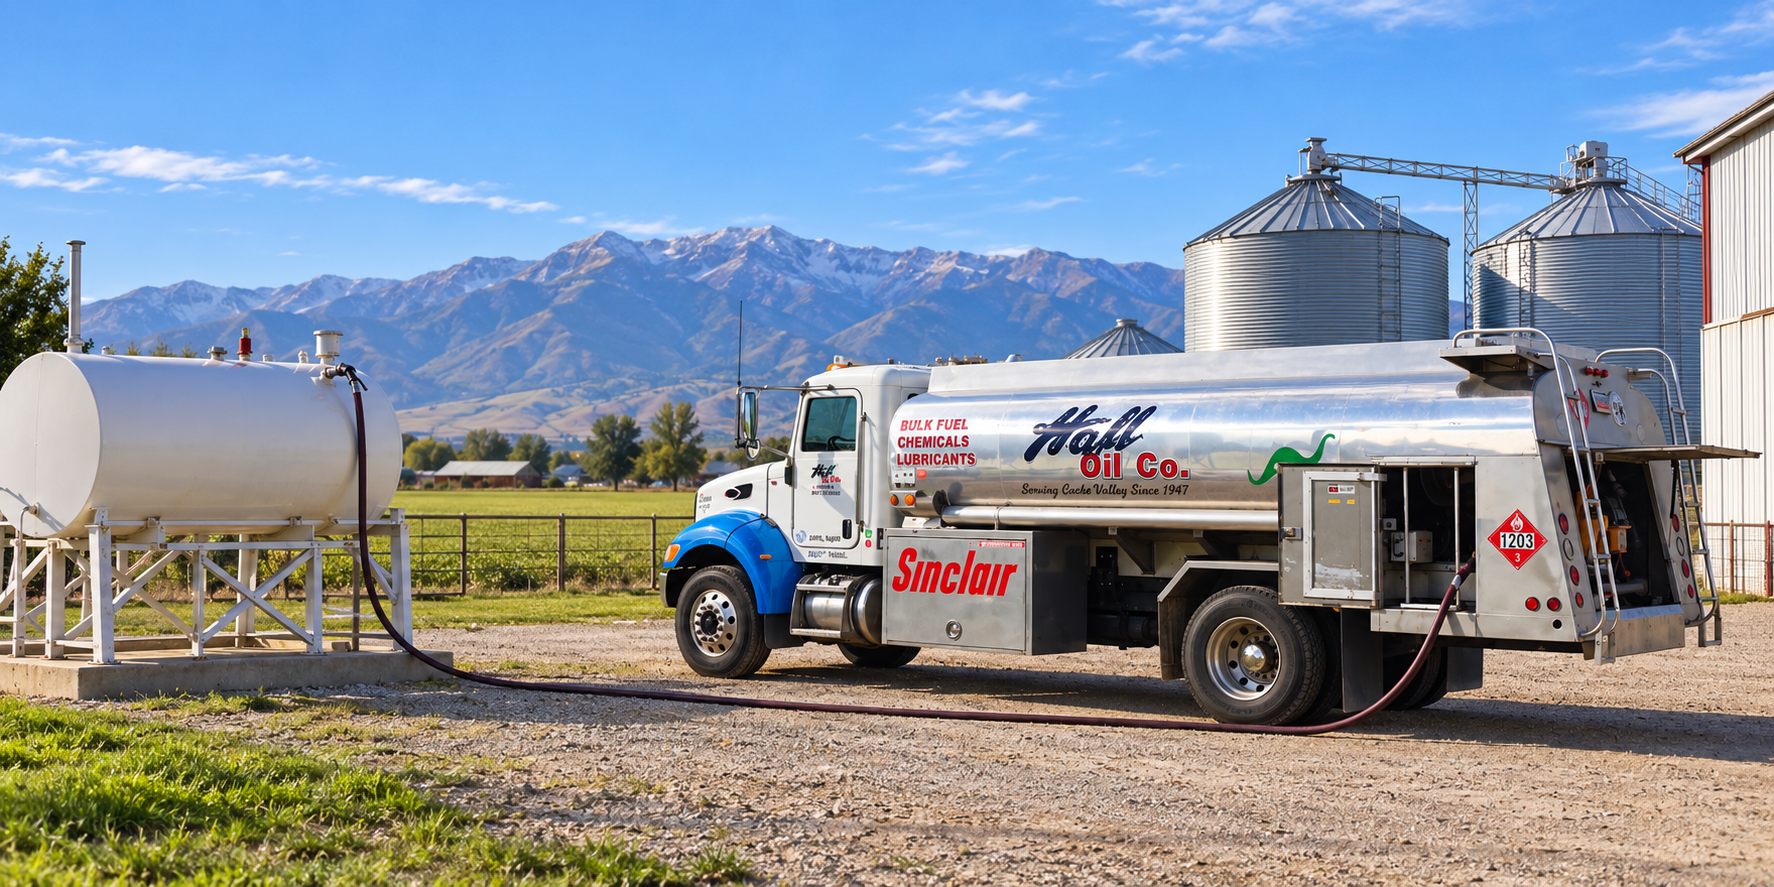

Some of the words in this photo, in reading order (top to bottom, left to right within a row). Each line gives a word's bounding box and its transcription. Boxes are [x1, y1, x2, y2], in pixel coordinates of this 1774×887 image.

[900, 419, 933, 431] BULK
[936, 418, 968, 430] FUEL
[1024, 404, 1157, 462] Hall
[897, 435, 969, 449] CHEMICALS
[896, 452, 976, 466] LUBRICANTS
[1079, 451, 1123, 480] Oil
[1136, 452, 1191, 480] Co.
[1061, 482, 1092, 495] Cache
[1093, 483, 1128, 499] Valley
[1130, 483, 1160, 495] Since
[1163, 484, 1189, 496] 1947
[1501, 533, 1533, 549] 1203
[1515, 552, 1521, 563] 3
[892, 547, 1018, 597] Sinclair
